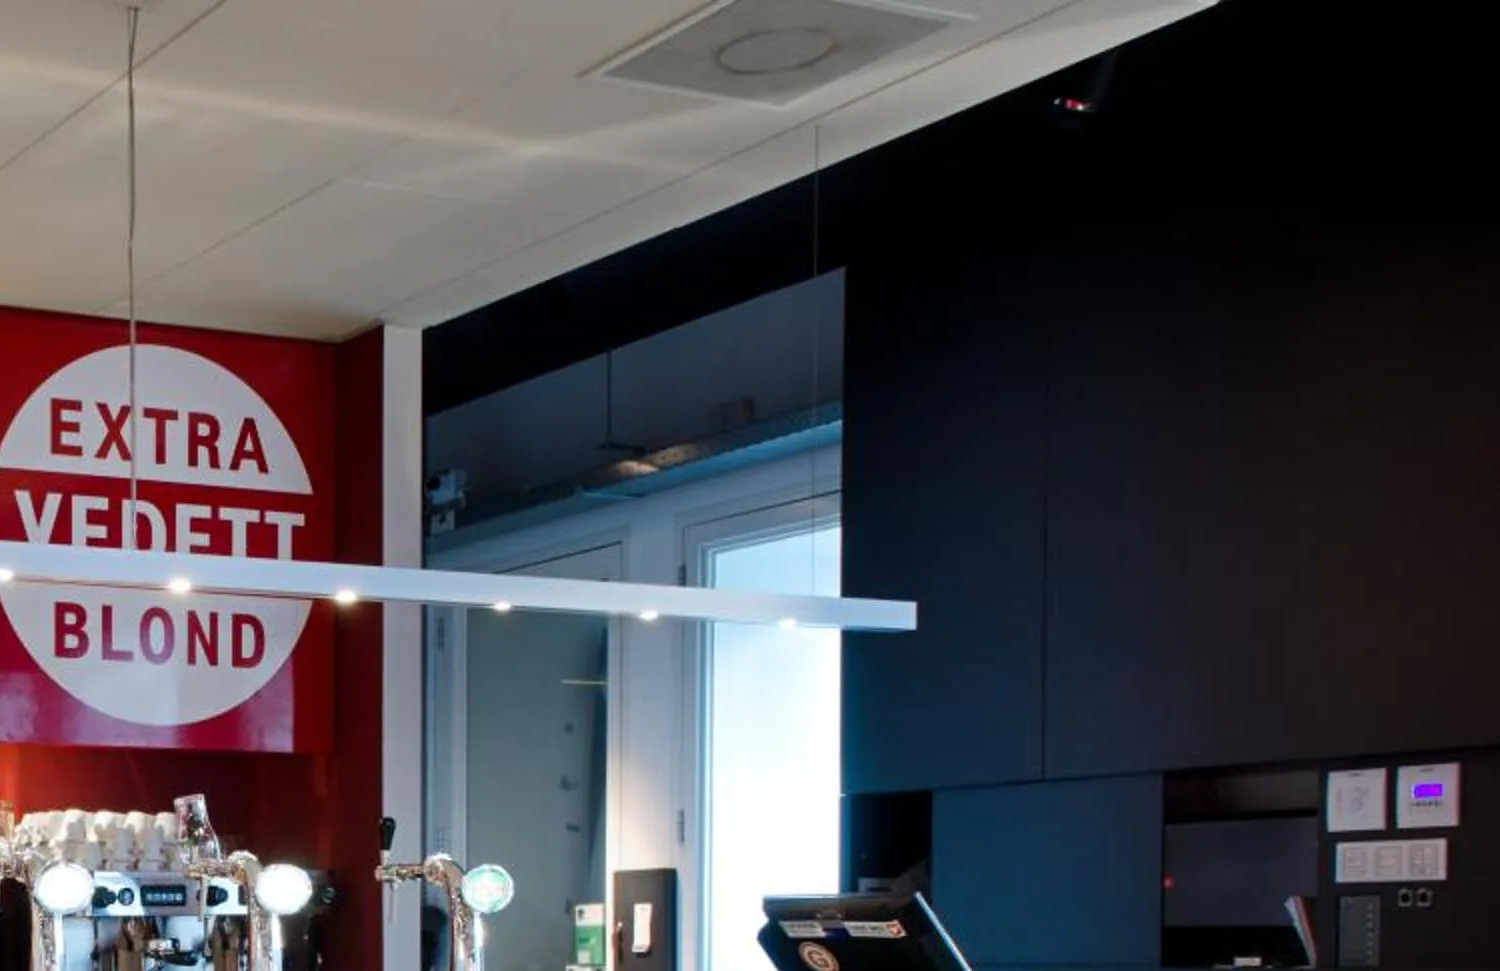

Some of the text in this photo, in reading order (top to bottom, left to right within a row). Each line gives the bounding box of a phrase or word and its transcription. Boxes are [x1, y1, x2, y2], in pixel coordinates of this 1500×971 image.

[49, 397, 270, 475] EXTRA
[14, 489, 306, 562] VEDETT
[53, 601, 266, 669] BLOND
